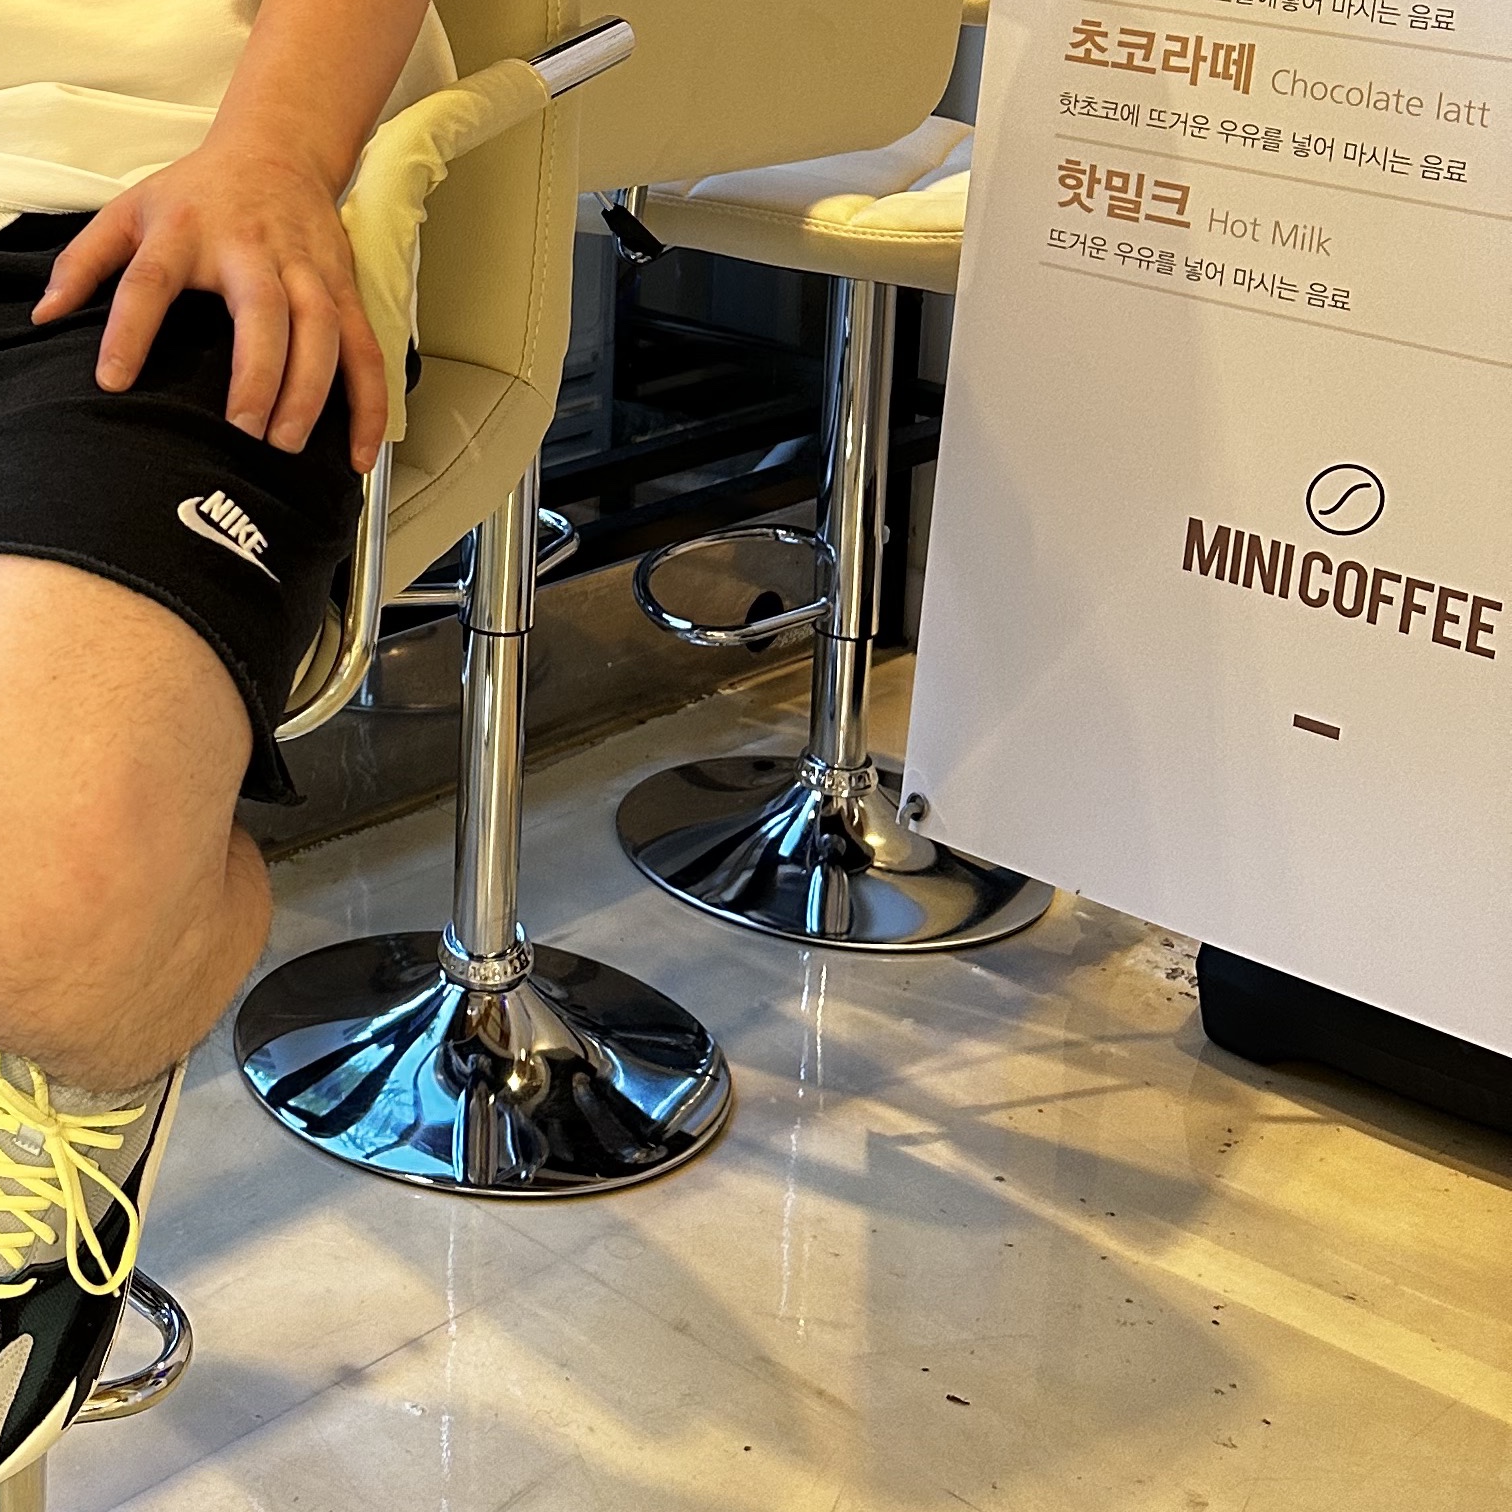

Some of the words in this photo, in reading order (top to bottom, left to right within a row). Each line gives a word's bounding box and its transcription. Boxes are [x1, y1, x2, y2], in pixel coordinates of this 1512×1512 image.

[1407, 3, 1457, 32] 음료
[1064, 18, 1256, 95] 초코라떼
[1271, 69, 1424, 118] Chocolate
[1435, 92, 1491, 129] latt
[1059, 91, 1141, 128] 핫초코에
[1145, 108, 1211, 141] 뜨거운
[1216, 119, 1285, 153] 우유를
[1291, 131, 1336, 162] 넣어
[1343, 141, 1414, 177] 마시는
[1419, 154, 1468, 184] 음료
[1056, 158, 1192, 229] 핫밀크
[1208, 207, 1261, 244] Hot
[1271, 219, 1333, 257] Milk
[1047, 228, 1109, 261] 뜨거운
[1113, 242, 1177, 276] 우유를
[1184, 257, 1226, 287] 넣어
[1232, 267, 1301, 303] 마시는
[1305, 282, 1352, 312] 음료
[199, 489, 268, 554] NIKE
